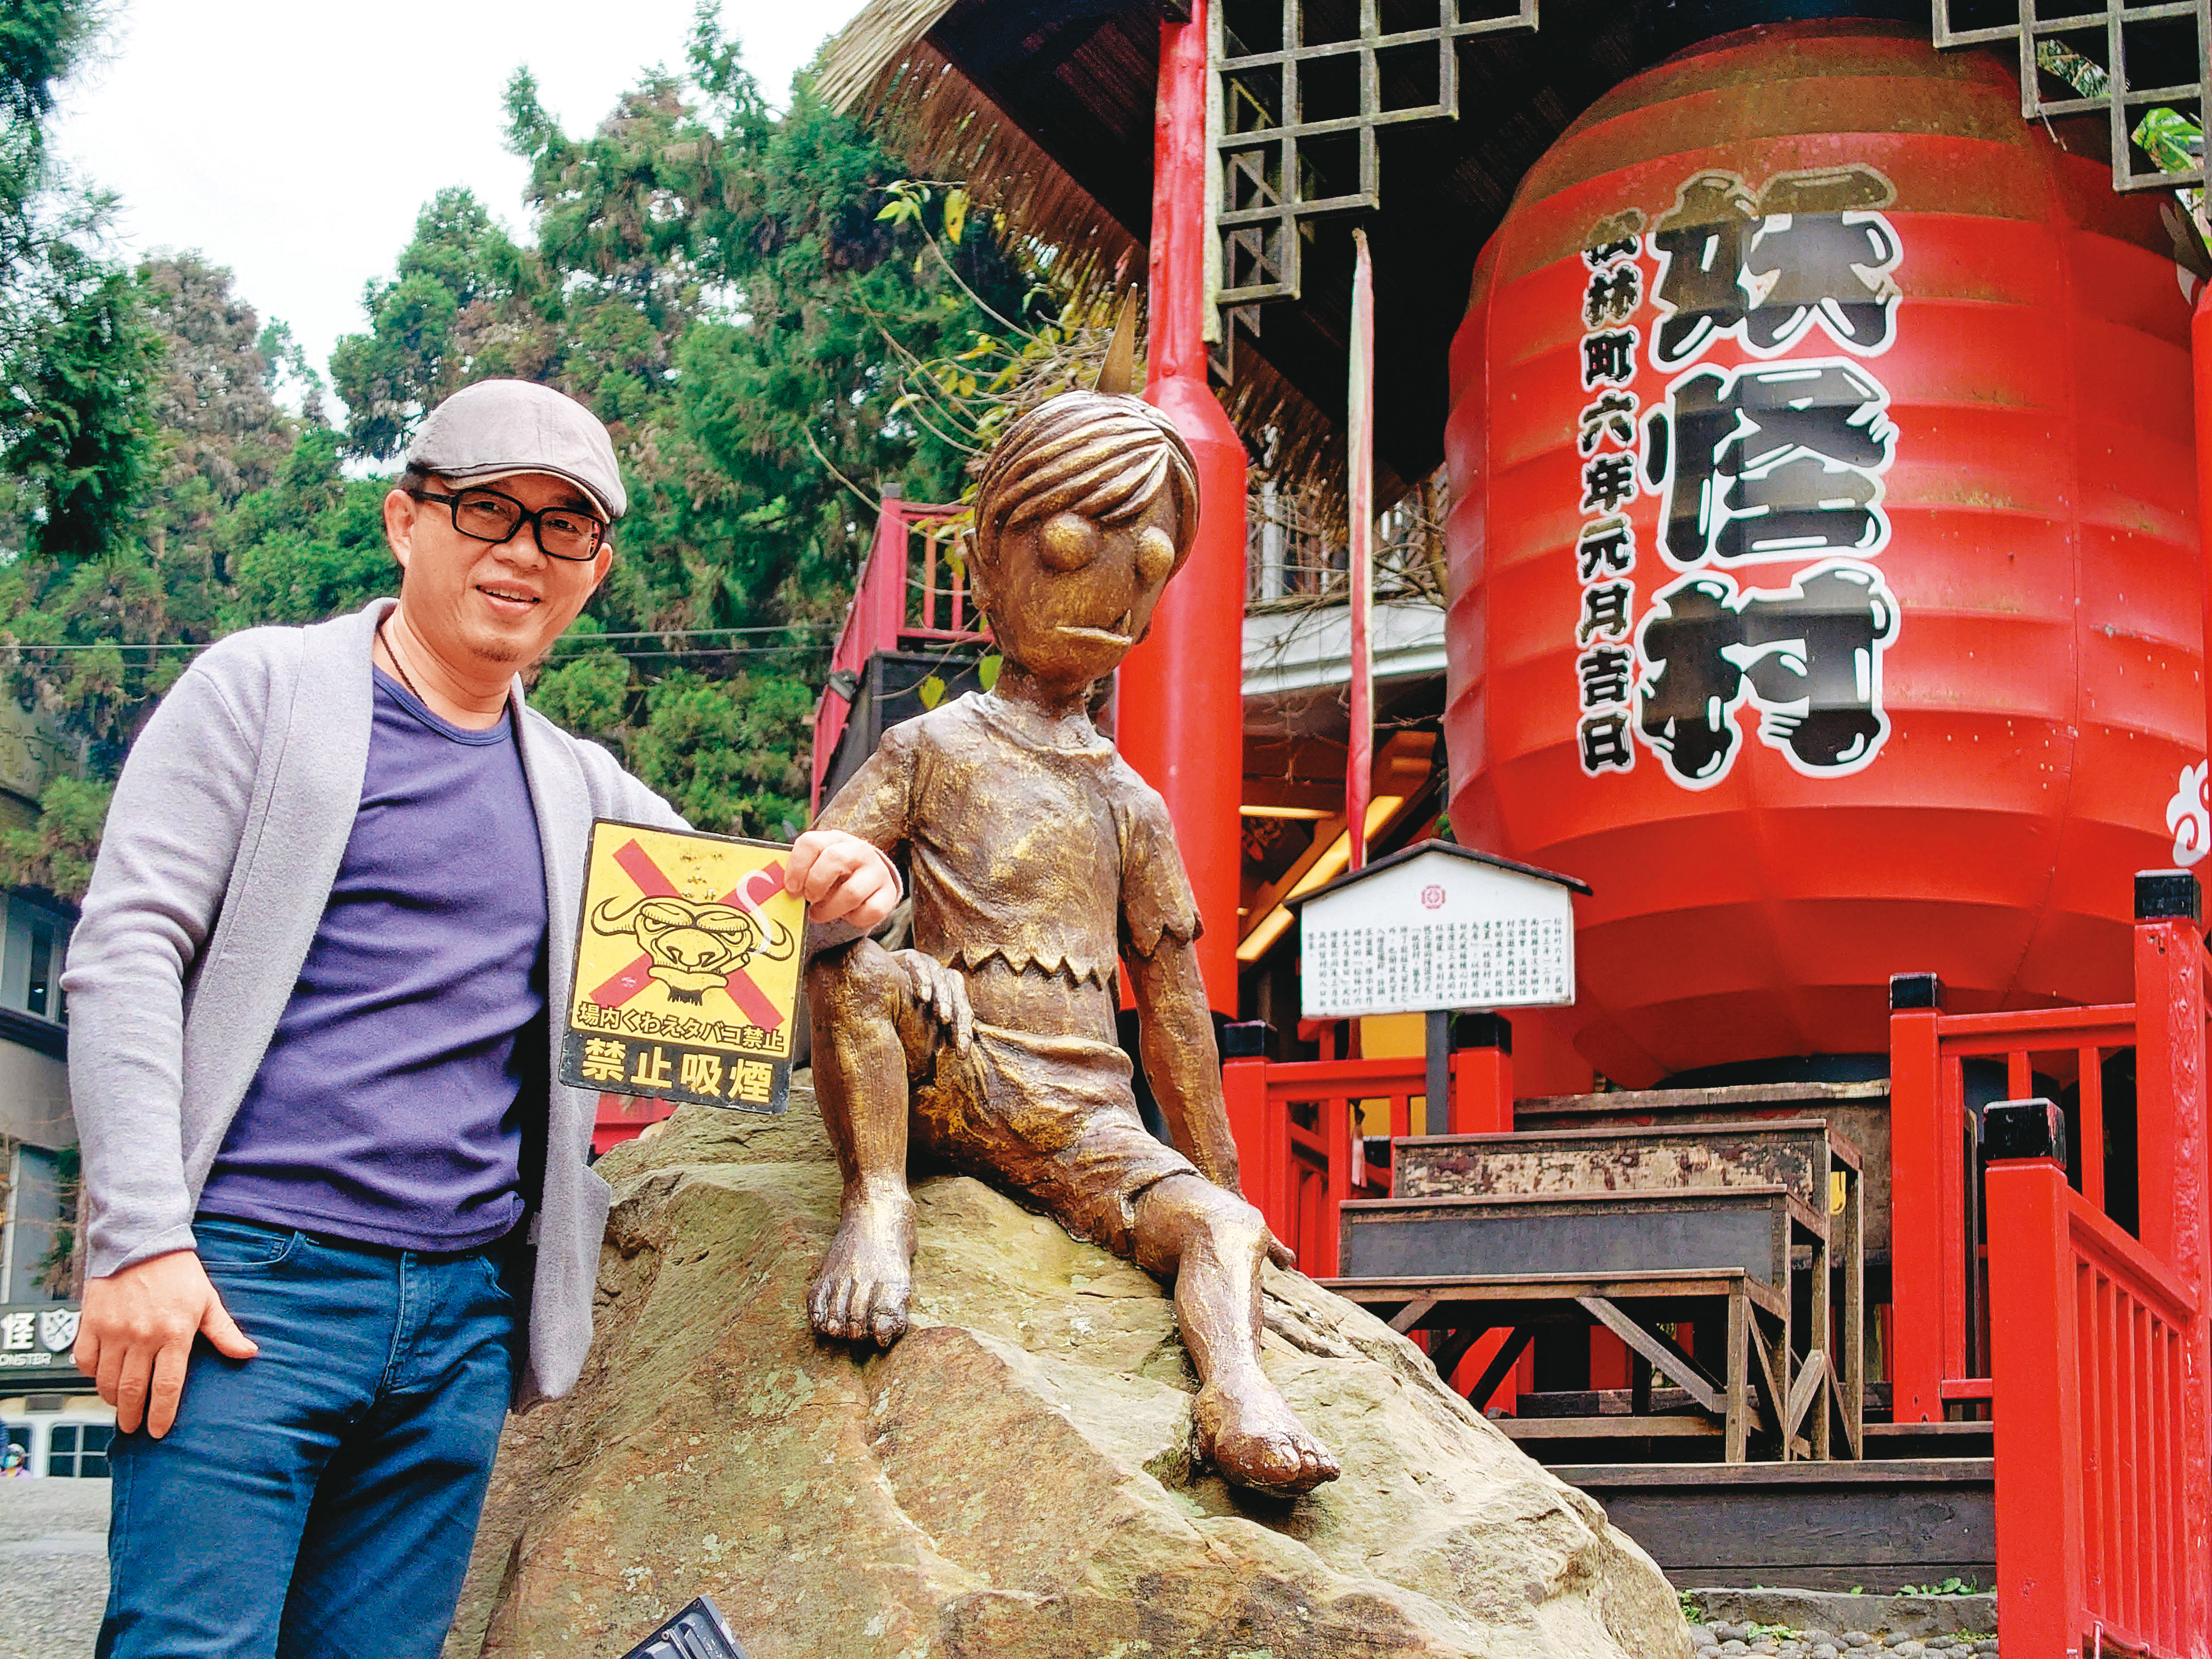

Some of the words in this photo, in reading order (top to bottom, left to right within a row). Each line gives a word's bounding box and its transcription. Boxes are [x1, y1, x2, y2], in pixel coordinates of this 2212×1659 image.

[1634, 166, 1903, 790] 妖怪村
[577, 1001, 785, 1052] 場内くわえタバコ禁止
[582, 1037, 774, 1103] 禁止吸煙
[0, 1312, 35, 1350] 怪
